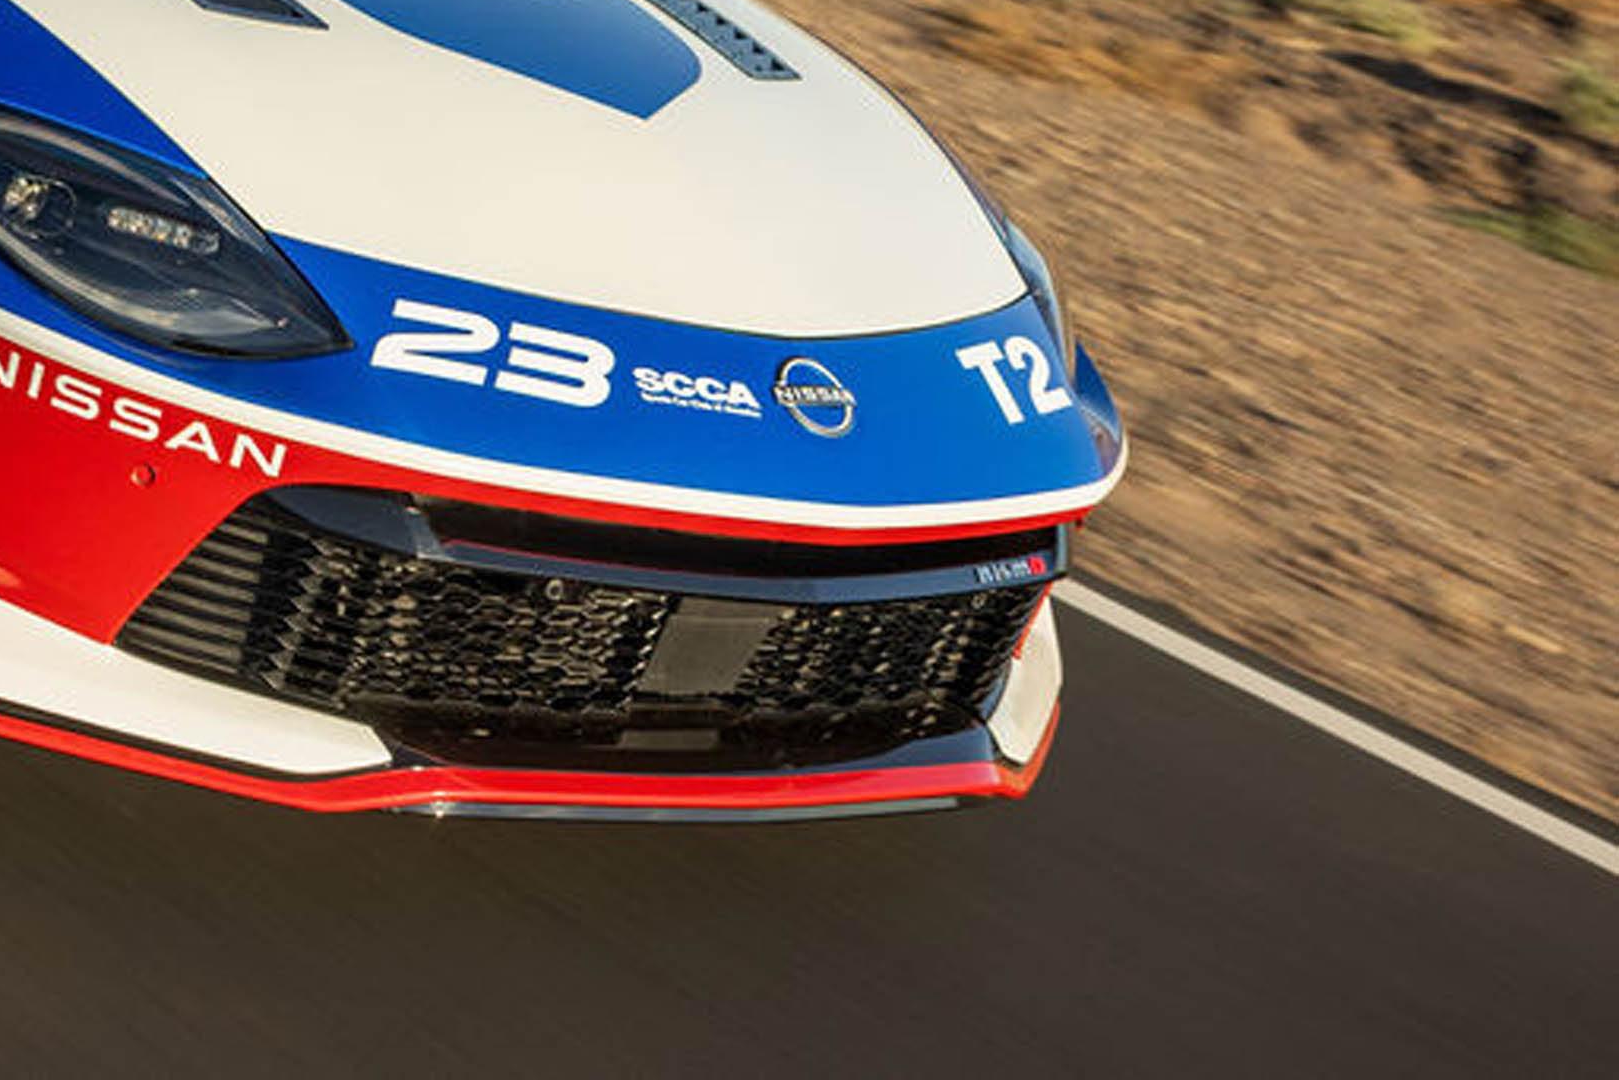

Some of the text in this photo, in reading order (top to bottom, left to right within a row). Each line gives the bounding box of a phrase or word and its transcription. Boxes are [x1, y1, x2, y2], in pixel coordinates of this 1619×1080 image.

[370, 297, 616, 408] 23
[632, 366, 762, 410] SCCA
[954, 335, 1074, 425] T2
